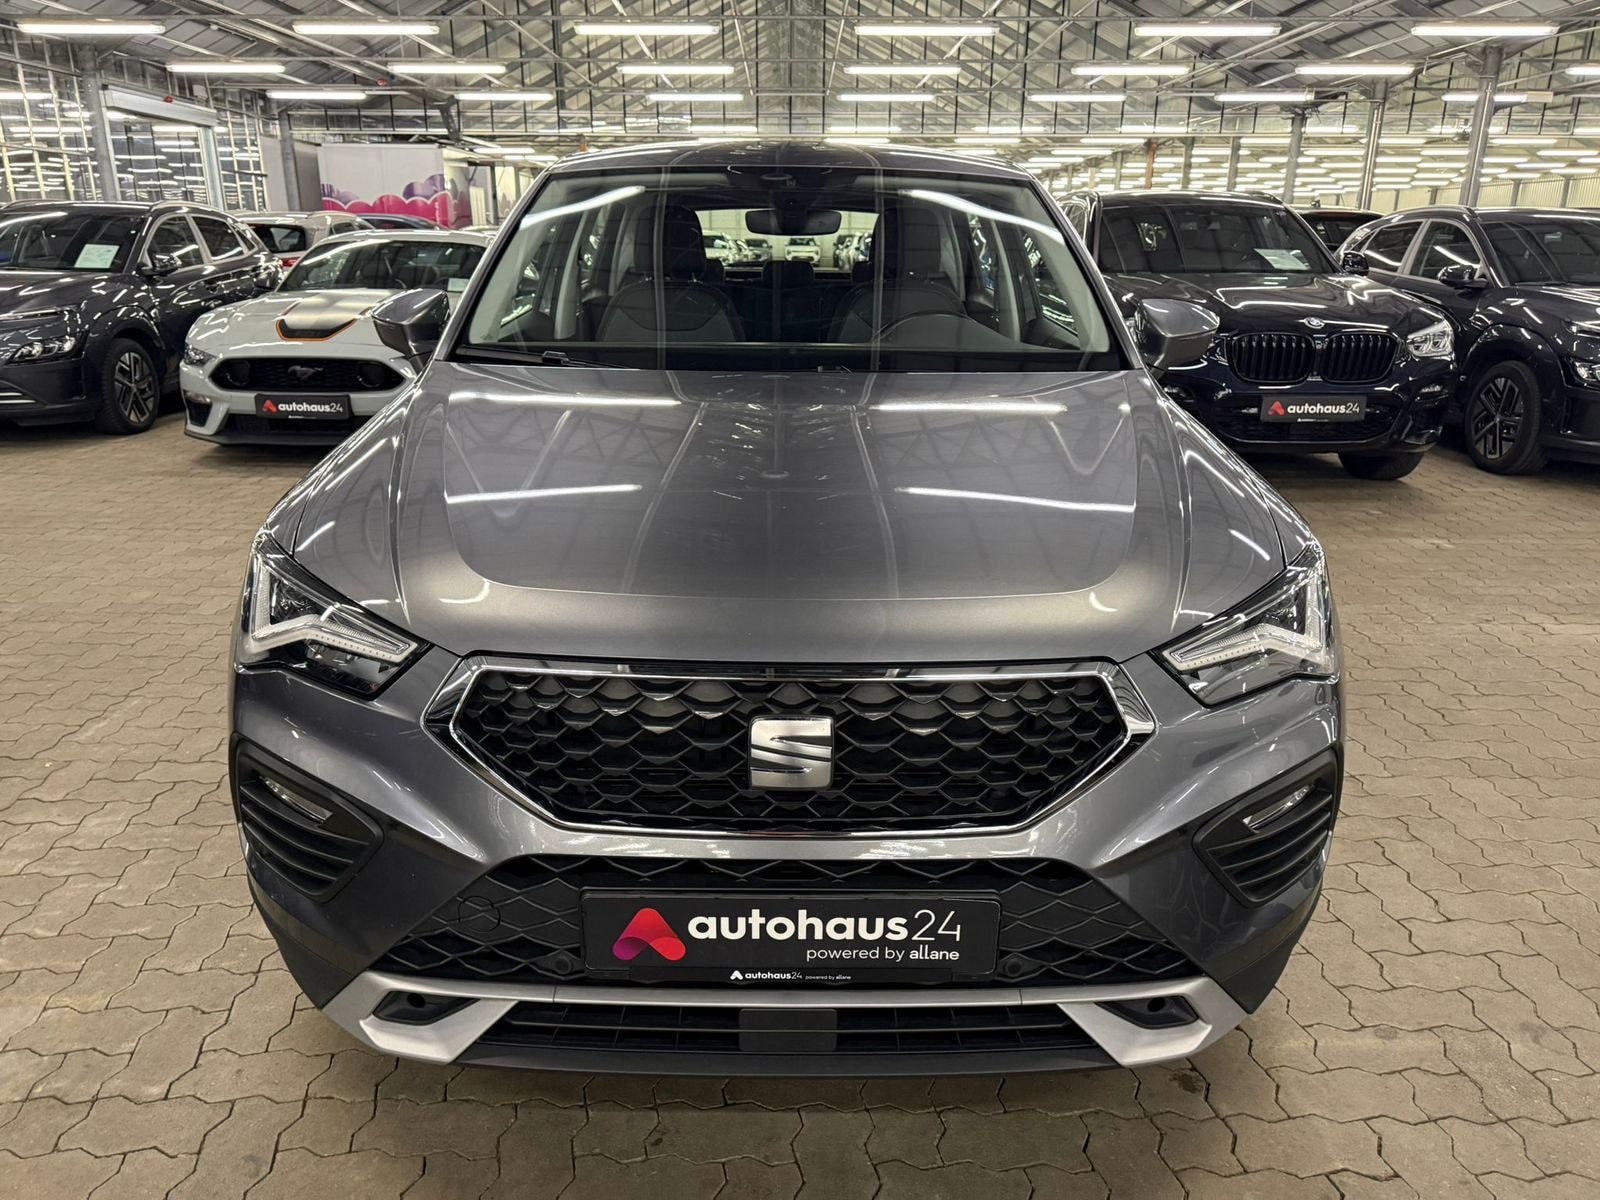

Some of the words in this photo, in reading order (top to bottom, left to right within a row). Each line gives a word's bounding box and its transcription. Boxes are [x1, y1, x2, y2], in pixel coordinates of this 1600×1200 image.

[278, 402, 344, 413] autohaus24
[1287, 402, 1360, 414] autohaus24
[688, 908, 961, 942] autohaus24
[806, 946, 880, 962] powered
[884, 946, 905, 963] by
[909, 944, 960, 961] allane
[744, 971, 803, 980] autohaus24
